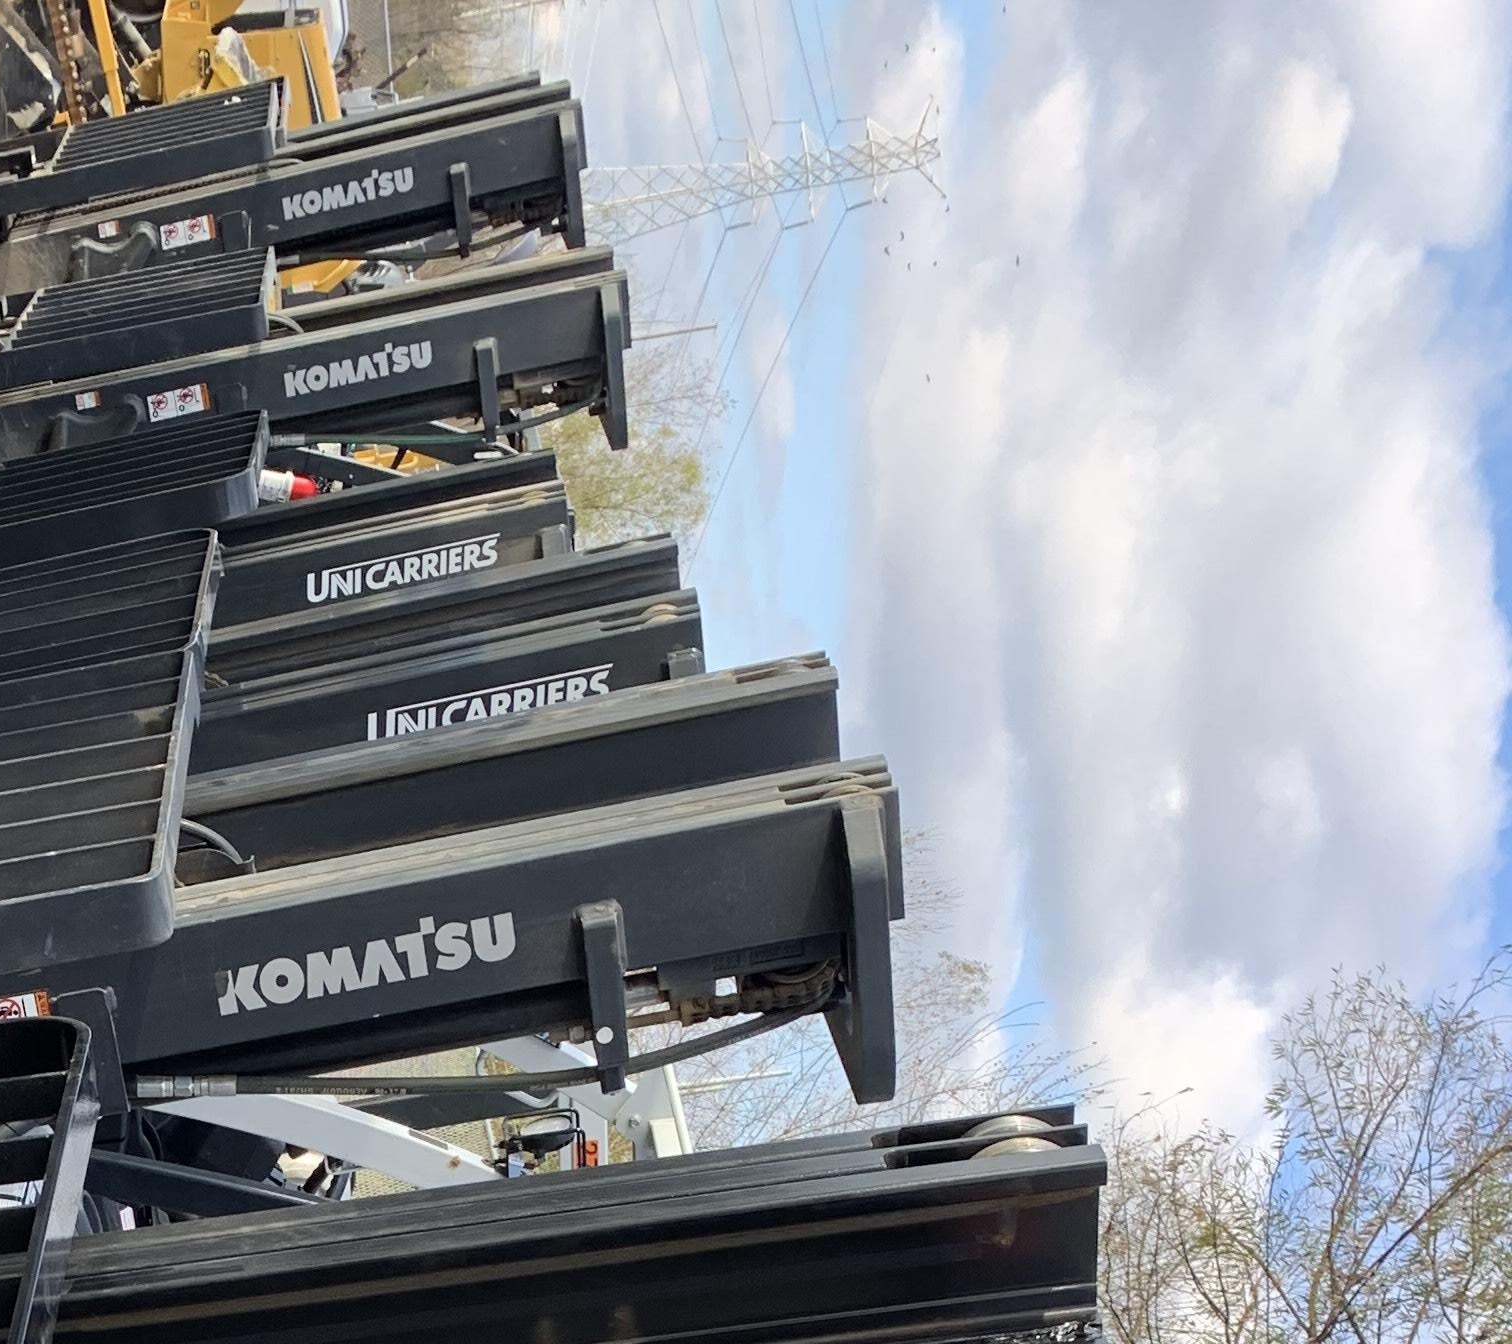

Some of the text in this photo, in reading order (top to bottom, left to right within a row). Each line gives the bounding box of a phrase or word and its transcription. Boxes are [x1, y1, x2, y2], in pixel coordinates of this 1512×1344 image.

[282, 166, 414, 221] KOMATSU
[284, 341, 433, 399] KOMATSU
[218, 913, 516, 1016] KOMATSU
